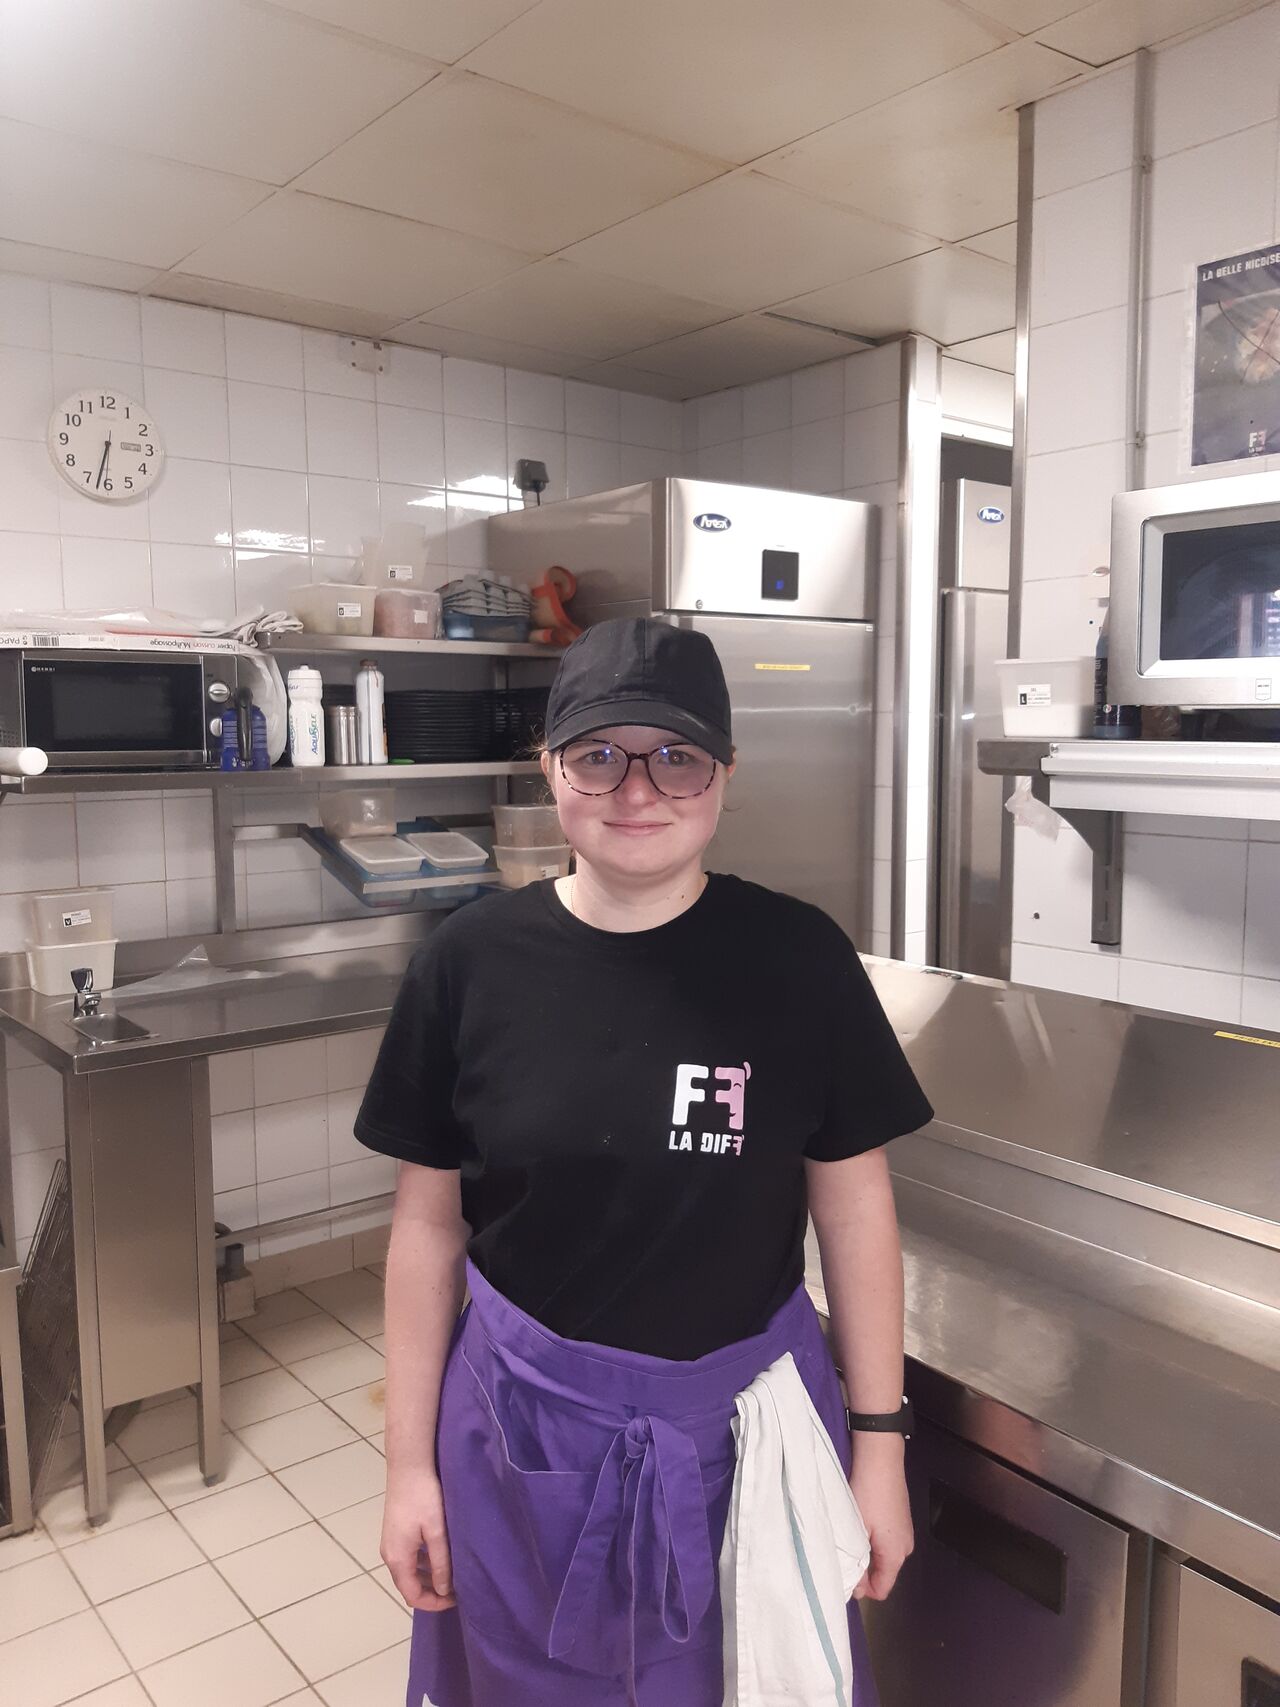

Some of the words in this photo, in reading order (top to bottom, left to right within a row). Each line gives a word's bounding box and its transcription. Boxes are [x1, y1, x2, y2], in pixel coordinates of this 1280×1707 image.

[1202, 270, 1214, 282] LA
[1216, 262, 1243, 278] BELLE
[79, 400, 93, 414] 11
[100, 395, 116, 410] 12
[65, 413, 82, 427] 10
[124, 407, 130, 419] 1
[138, 423, 148, 437] 2
[59, 432, 69, 446] 9
[145, 444, 154, 457] 3
[65, 453, 76, 467] 8
[137, 462, 148, 475] 4
[83, 470, 92, 484] 7
[124, 476, 133, 489] 5
[103, 478, 113, 491] 6
[668, 1130, 693, 1152] LA
